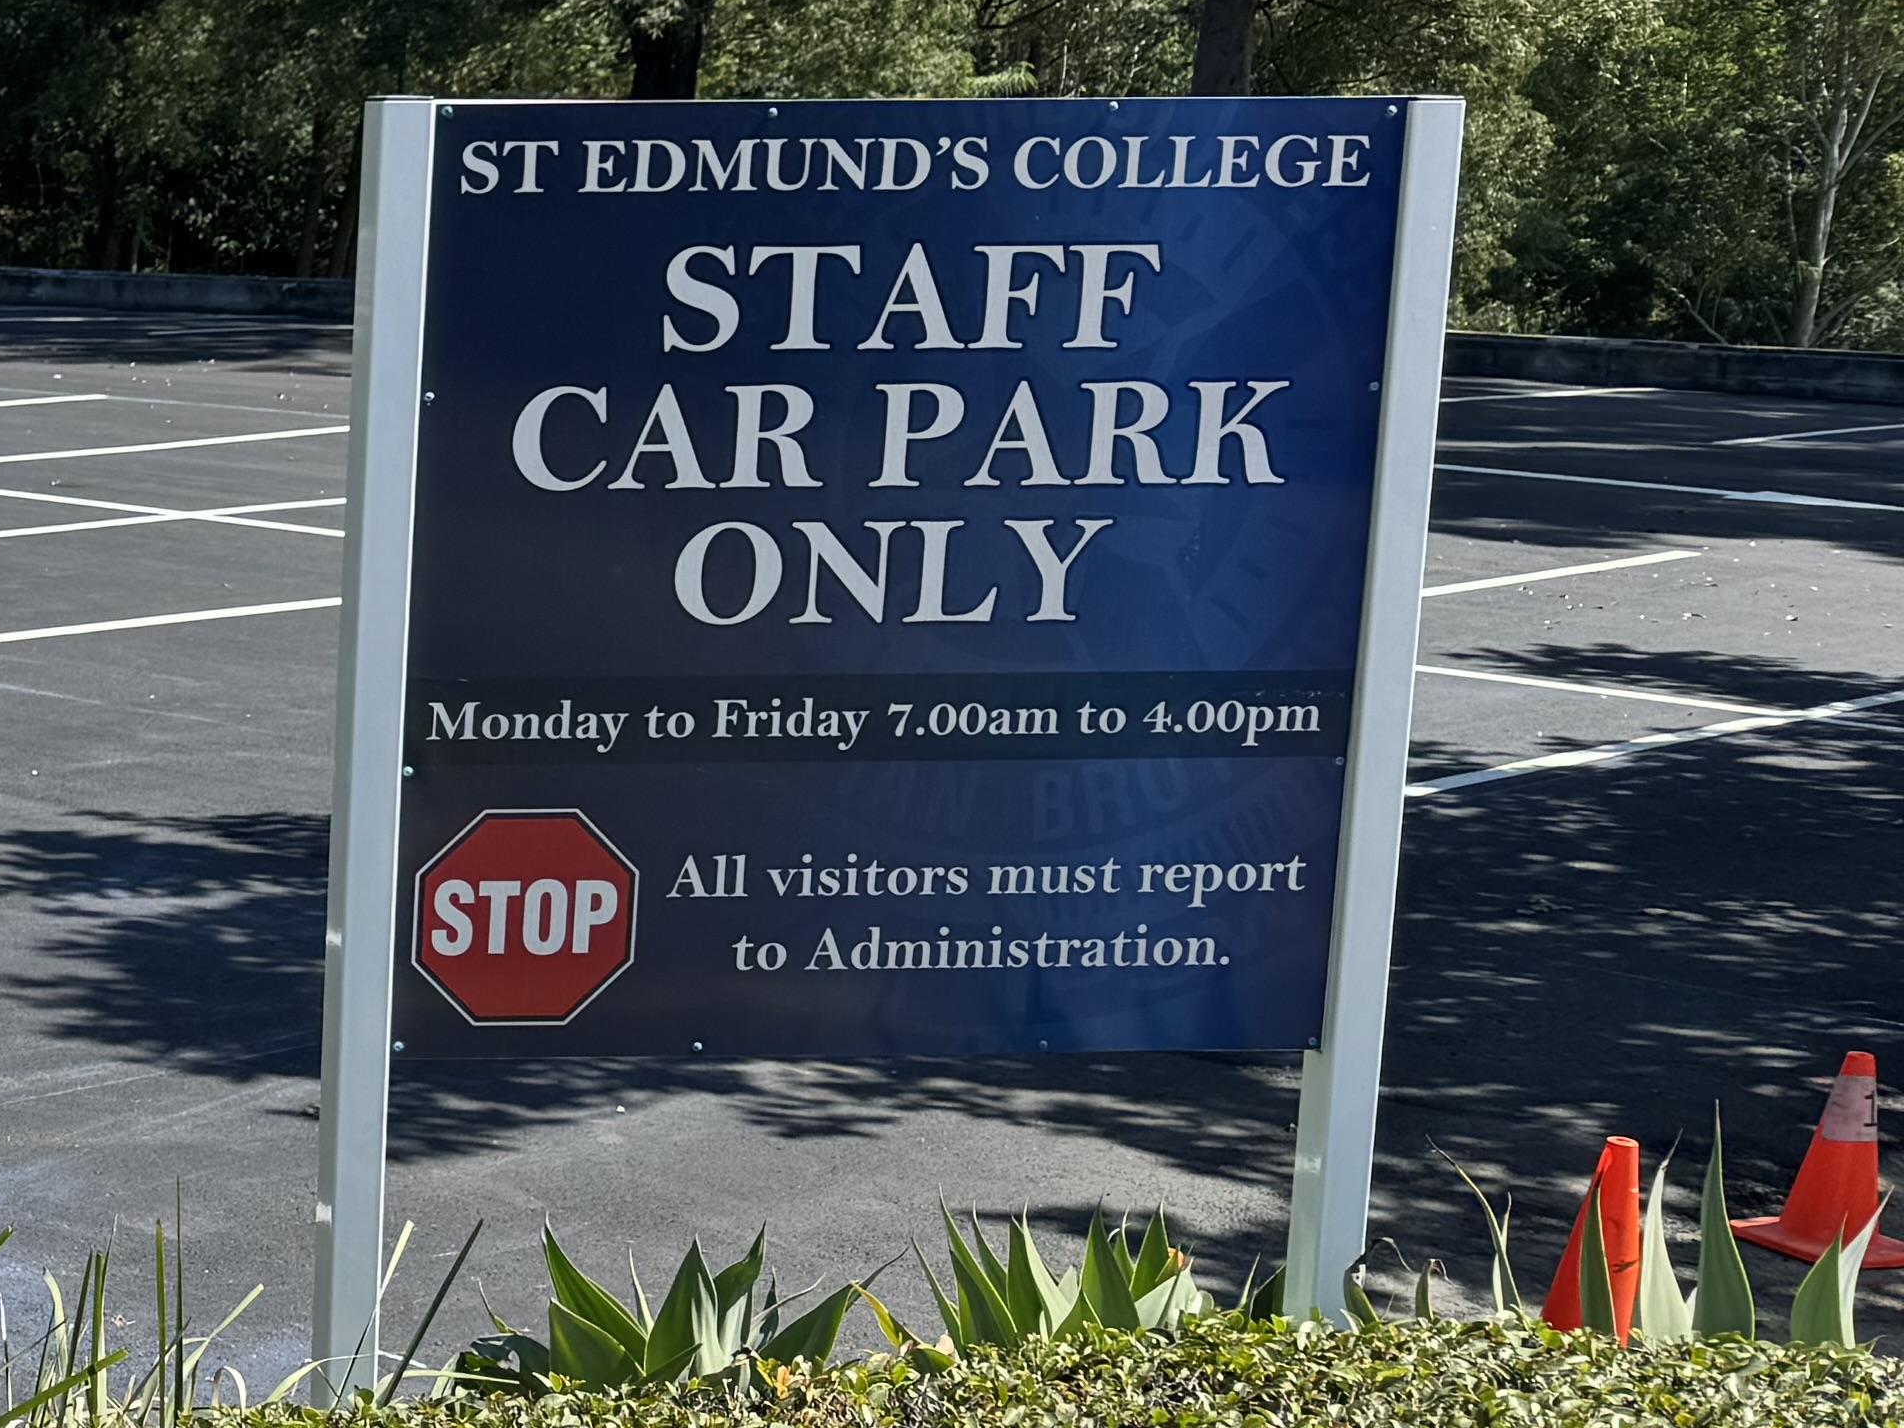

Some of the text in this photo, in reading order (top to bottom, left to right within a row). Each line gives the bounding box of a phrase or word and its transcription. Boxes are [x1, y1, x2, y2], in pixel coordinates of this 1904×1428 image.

[461, 134, 1370, 194] ST EDMUND’S COLLEGE
[663, 242, 1161, 353] STAFF
[512, 380, 1290, 491] CAR PARK
[674, 519, 1114, 625] ONLY
[426, 697, 1321, 753] Monday to Friday 7.00am to 4.00pm
[666, 853, 1307, 908] All visitors must report
[431, 878, 618, 957] STOP
[732, 923, 1230, 971] to Administration.
